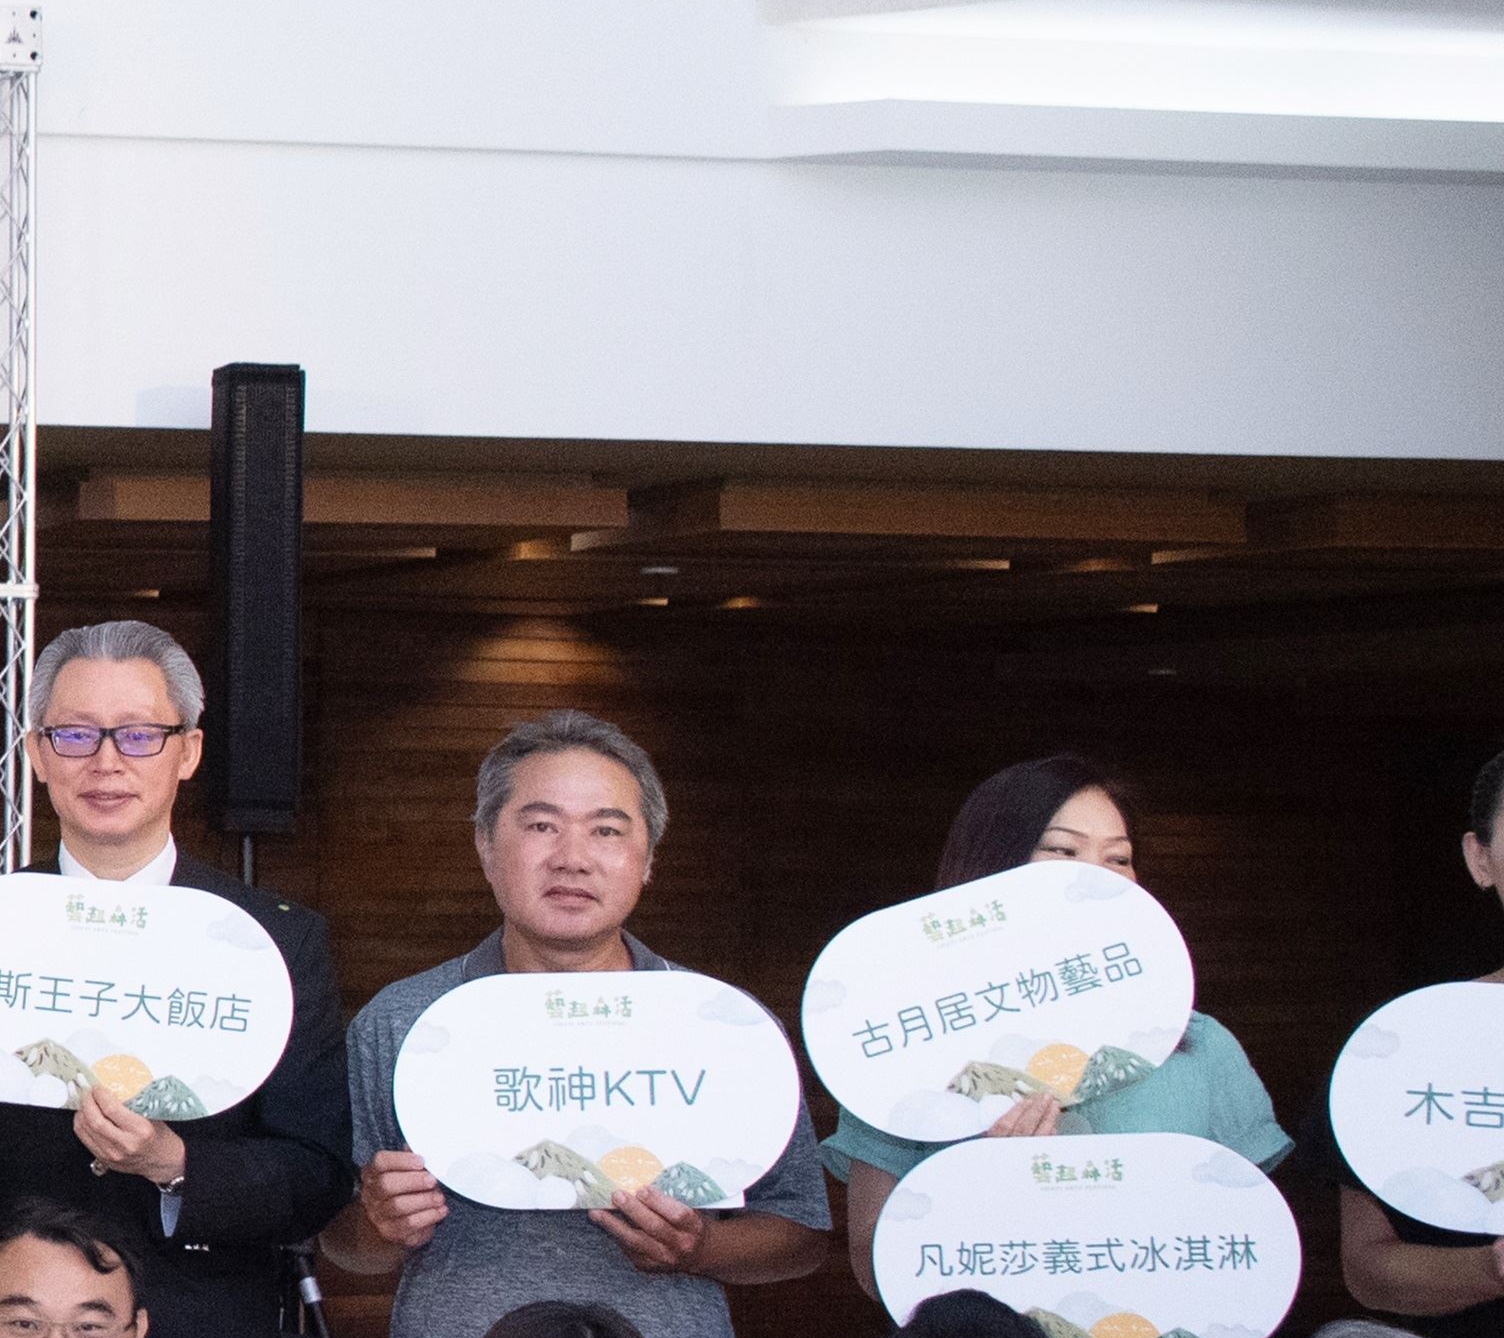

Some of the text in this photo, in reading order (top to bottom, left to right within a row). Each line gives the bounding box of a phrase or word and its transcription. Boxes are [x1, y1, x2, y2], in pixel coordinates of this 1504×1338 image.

[851, 941, 1144, 1060] 古月居文物藝品
[492, 1065, 706, 1112] 歌神KTV
[1404, 1081, 1504, 1129] 木吉
[915, 1234, 1258, 1278] 凡妮莎義式冰淇淋
